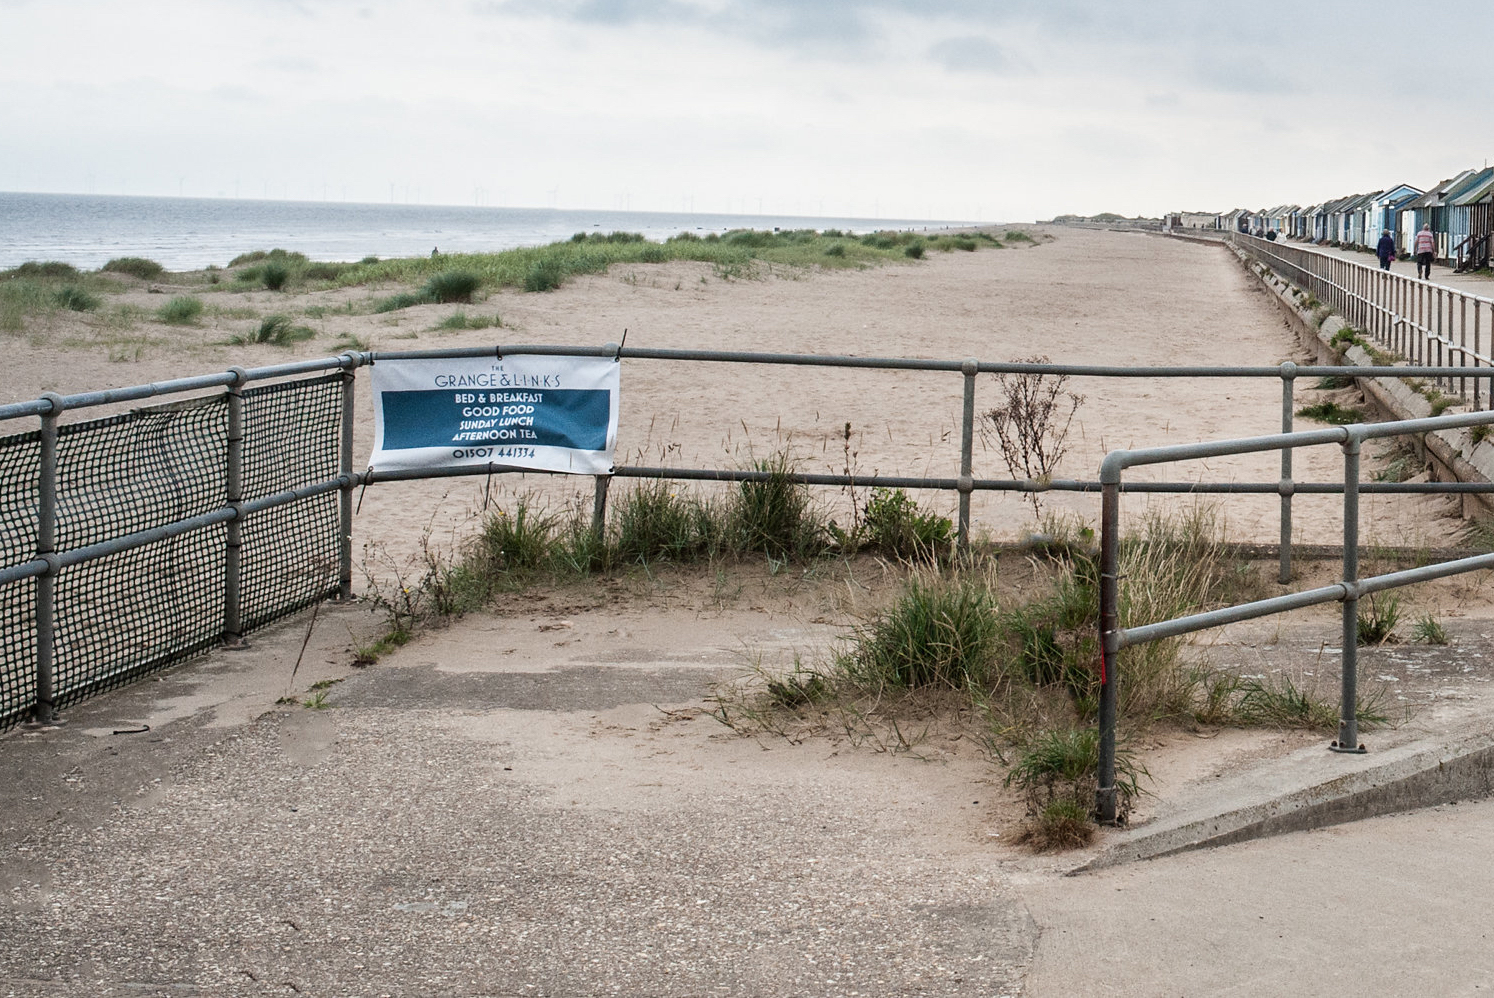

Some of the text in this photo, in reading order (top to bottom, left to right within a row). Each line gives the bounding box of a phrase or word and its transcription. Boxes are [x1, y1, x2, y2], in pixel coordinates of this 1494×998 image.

[435, 373, 497, 387] GRANGE
[500, 373, 511, 387] &
[455, 392, 543, 404] BED & BREAKFAST
[462, 404, 535, 417] GOOD FOOD
[459, 416, 534, 431] SUNDAY LUNCH
[452, 429, 538, 441] AFTERNOON TEA
[453, 447, 535, 459] 01507 441334
